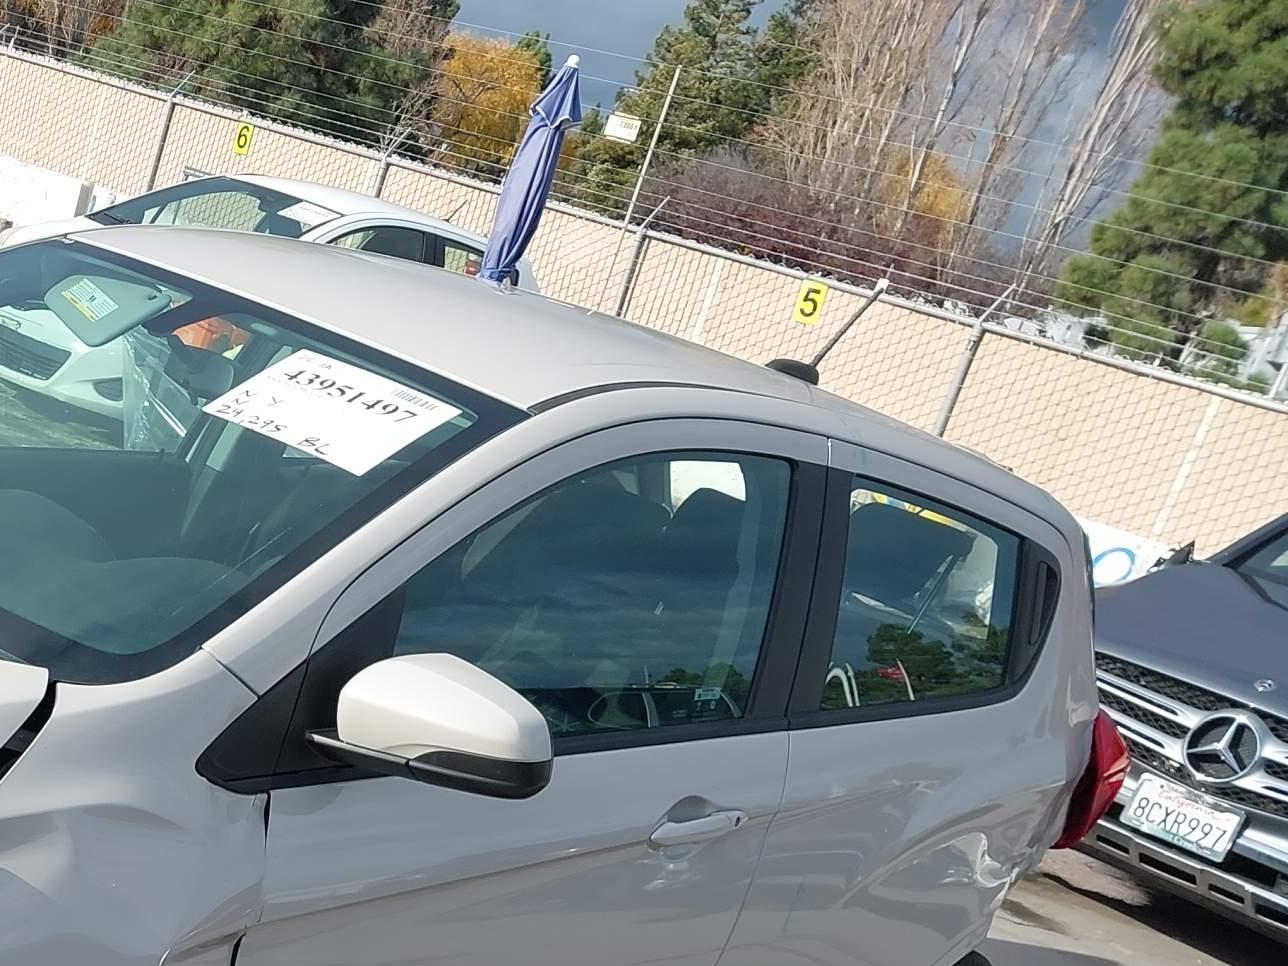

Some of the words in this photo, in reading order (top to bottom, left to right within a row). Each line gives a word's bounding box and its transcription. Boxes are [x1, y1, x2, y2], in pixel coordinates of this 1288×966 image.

[237, 125, 250, 149] 6
[799, 287, 822, 318] 5
[283, 369, 419, 423] 43951497
[1133, 797, 1227, 849] 8CXR997
